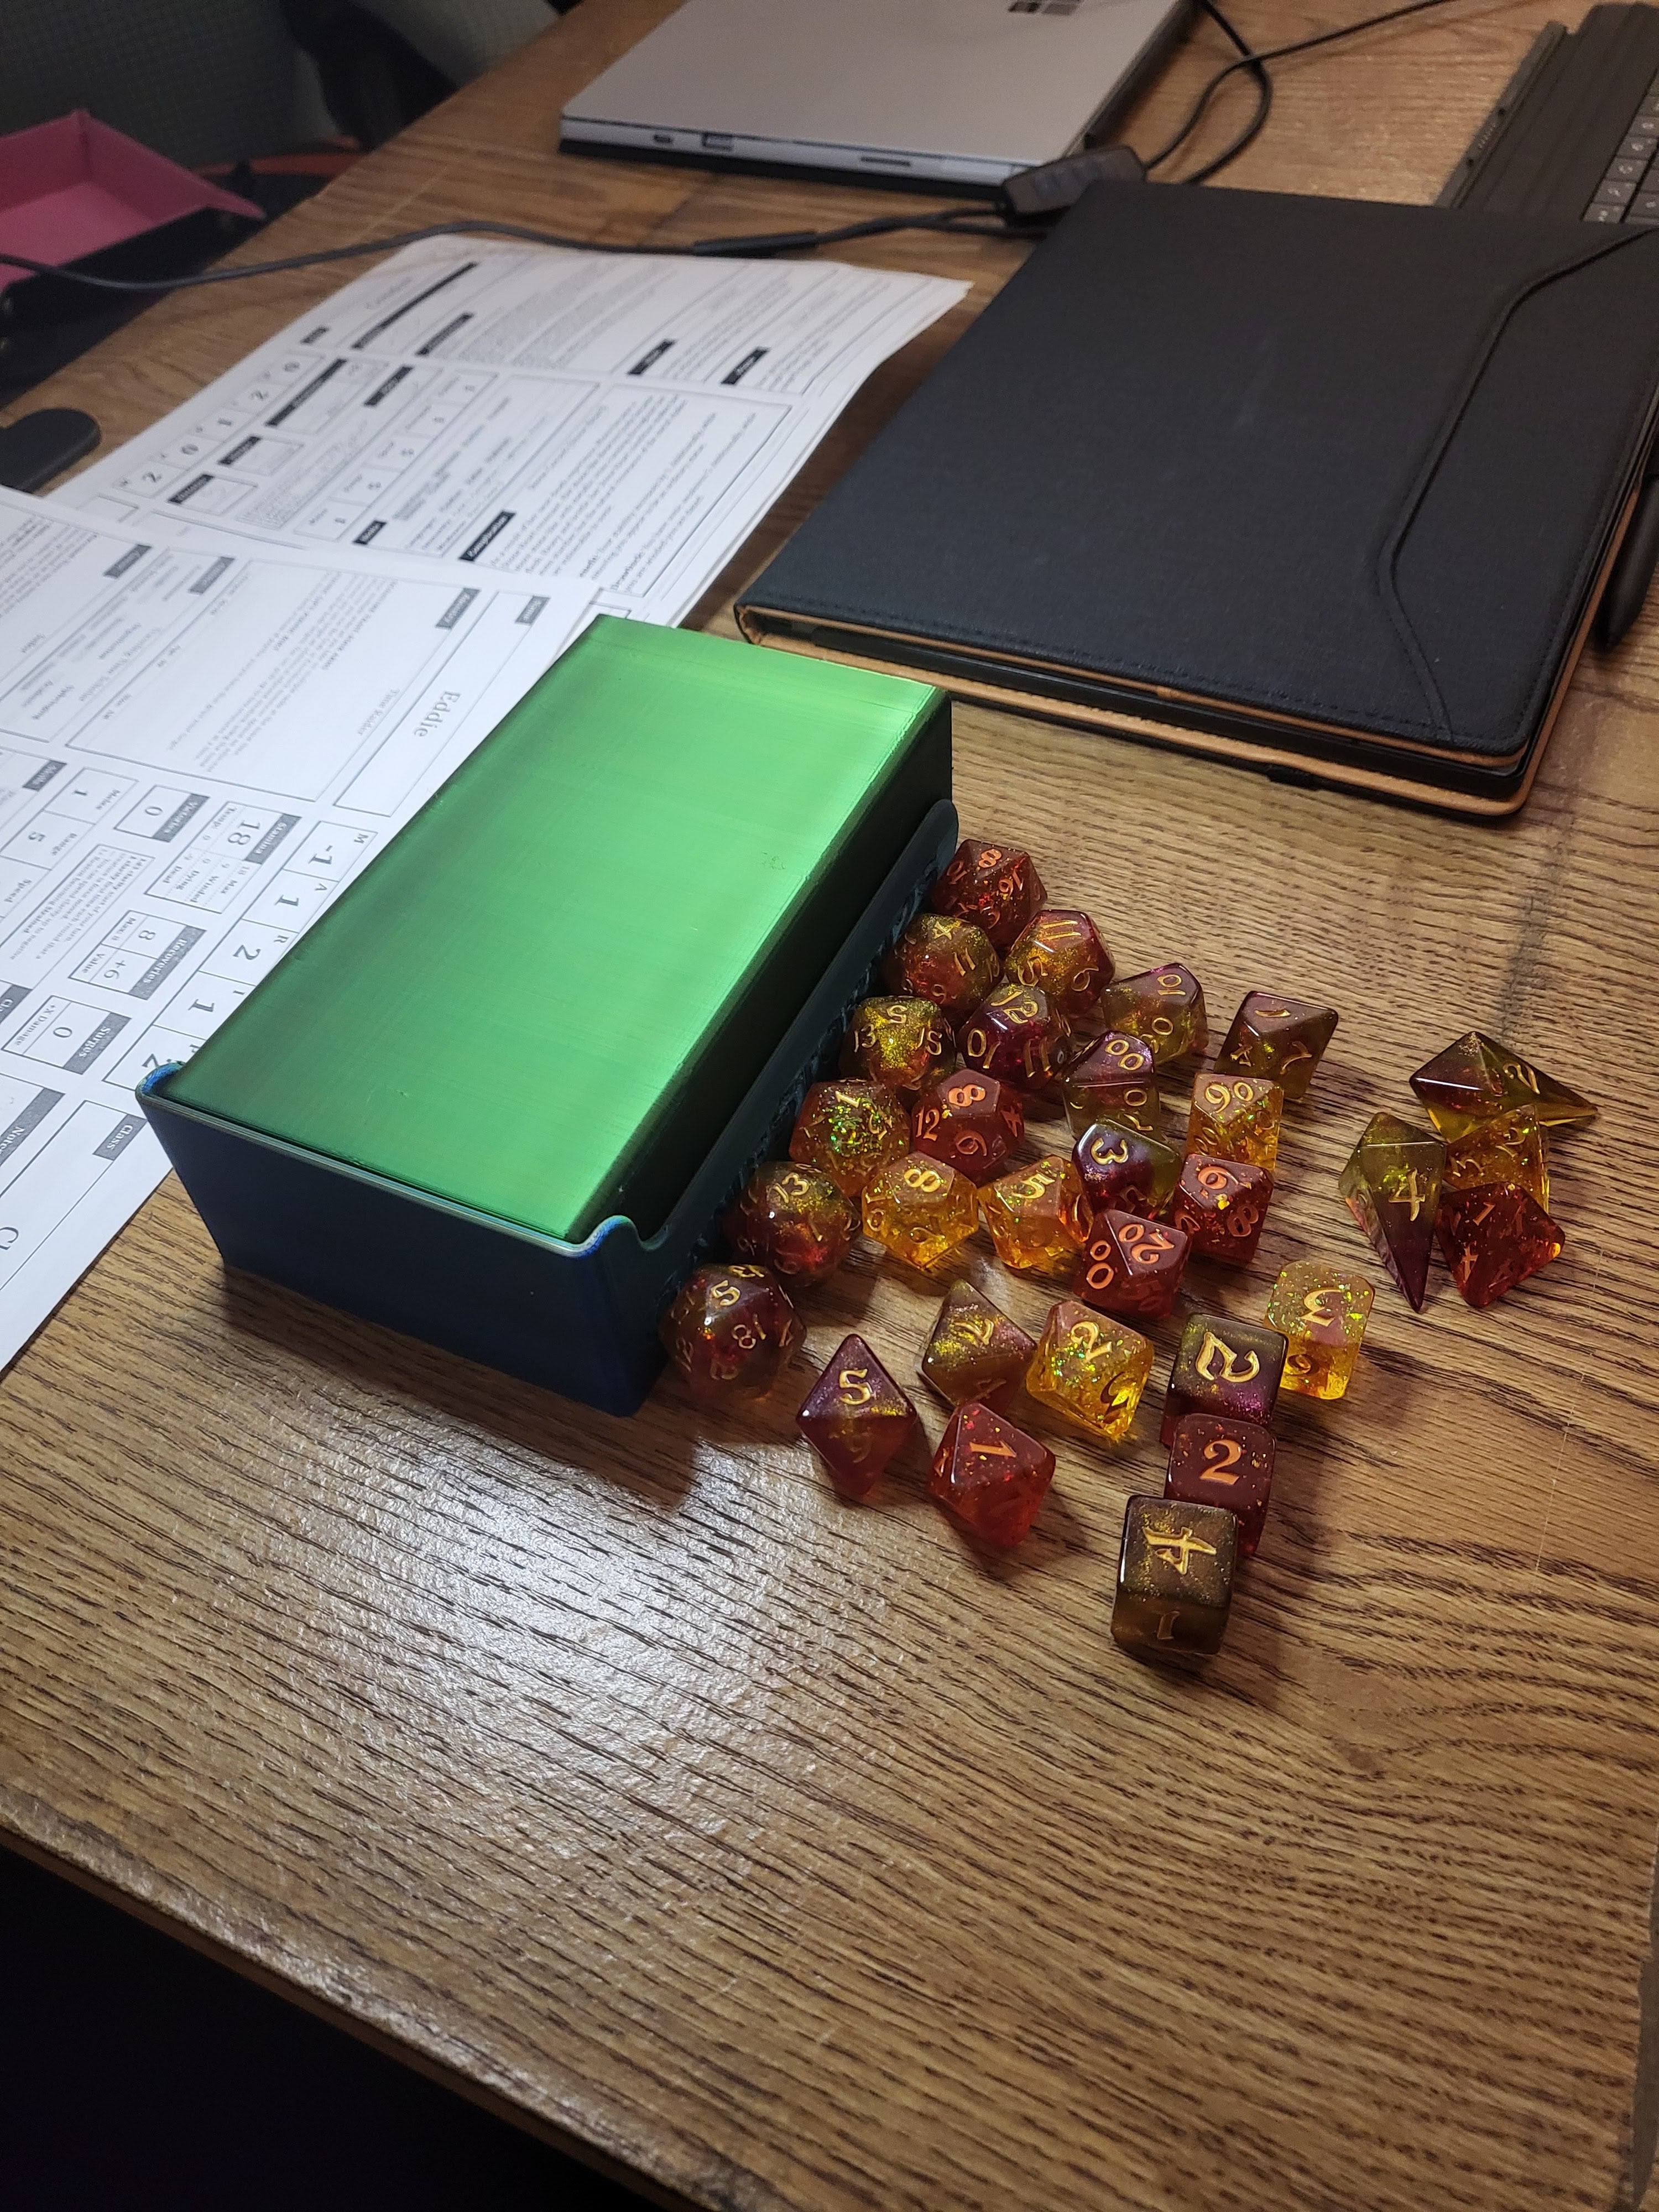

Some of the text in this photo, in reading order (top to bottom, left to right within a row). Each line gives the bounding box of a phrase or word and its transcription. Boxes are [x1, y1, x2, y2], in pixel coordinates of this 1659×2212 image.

[358, 688, 400, 736] Time Raider
[415, 691, 461, 737] Eddie
[145, 806, 163, 816] 0
[28, 832, 46, 842] 5
[228, 820, 260, 846] 18
[254, 822, 287, 854] Stamina
[354, 833, 369, 844] M
[308, 845, 333, 865] -1
[978, 849, 1002, 868] 8
[163, 865, 182, 884] Dead
[176, 870, 200, 890] Dying
[221, 880, 238, 894] Max
[315, 883, 327, 891] A
[4, 879, 32, 902] Speed
[190, 876, 219, 902] Winded
[274, 895, 299, 907] 1
[138, 930, 156, 941] 8
[274, 935, 289, 943] R
[1042, 920, 1082, 940] 11
[82, 953, 105, 974] Value
[143, 938, 187, 984] Recoveries
[233, 945, 261, 961] 2
[103, 960, 126, 979] +6
[188, 999, 215, 1012] 1
[991, 989, 1039, 1024] 12
[14, 1004, 55, 1046] +X Damage
[53, 1026, 72, 1038] 0
[853, 1023, 877, 1052] 13
[79, 1025, 111, 1058] Surges
[1106, 1040, 1144, 1071] 00
[947, 1083, 986, 1107] 8
[1205, 1081, 1254, 1113] 90
[915, 1107, 940, 1141] 12
[106, 1123, 134, 1152] Class
[1090, 1138, 1128, 1165] 3
[773, 1172, 808, 1203] 13
[904, 1168, 942, 1192] 8
[1012, 1173, 1055, 1199] 5
[1389, 1167, 1425, 1222] 4
[1118, 1224, 1175, 1265] 20
[711, 1280, 740, 1306] 5
[1301, 1286, 1343, 1327] 3
[1071, 1321, 1112, 1361] 2
[839, 1369, 871, 1405] 5
[971, 1440, 1016, 1457] 1
[1199, 1439, 1242, 1485] 2
[1143, 1527, 1217, 1575] 4
